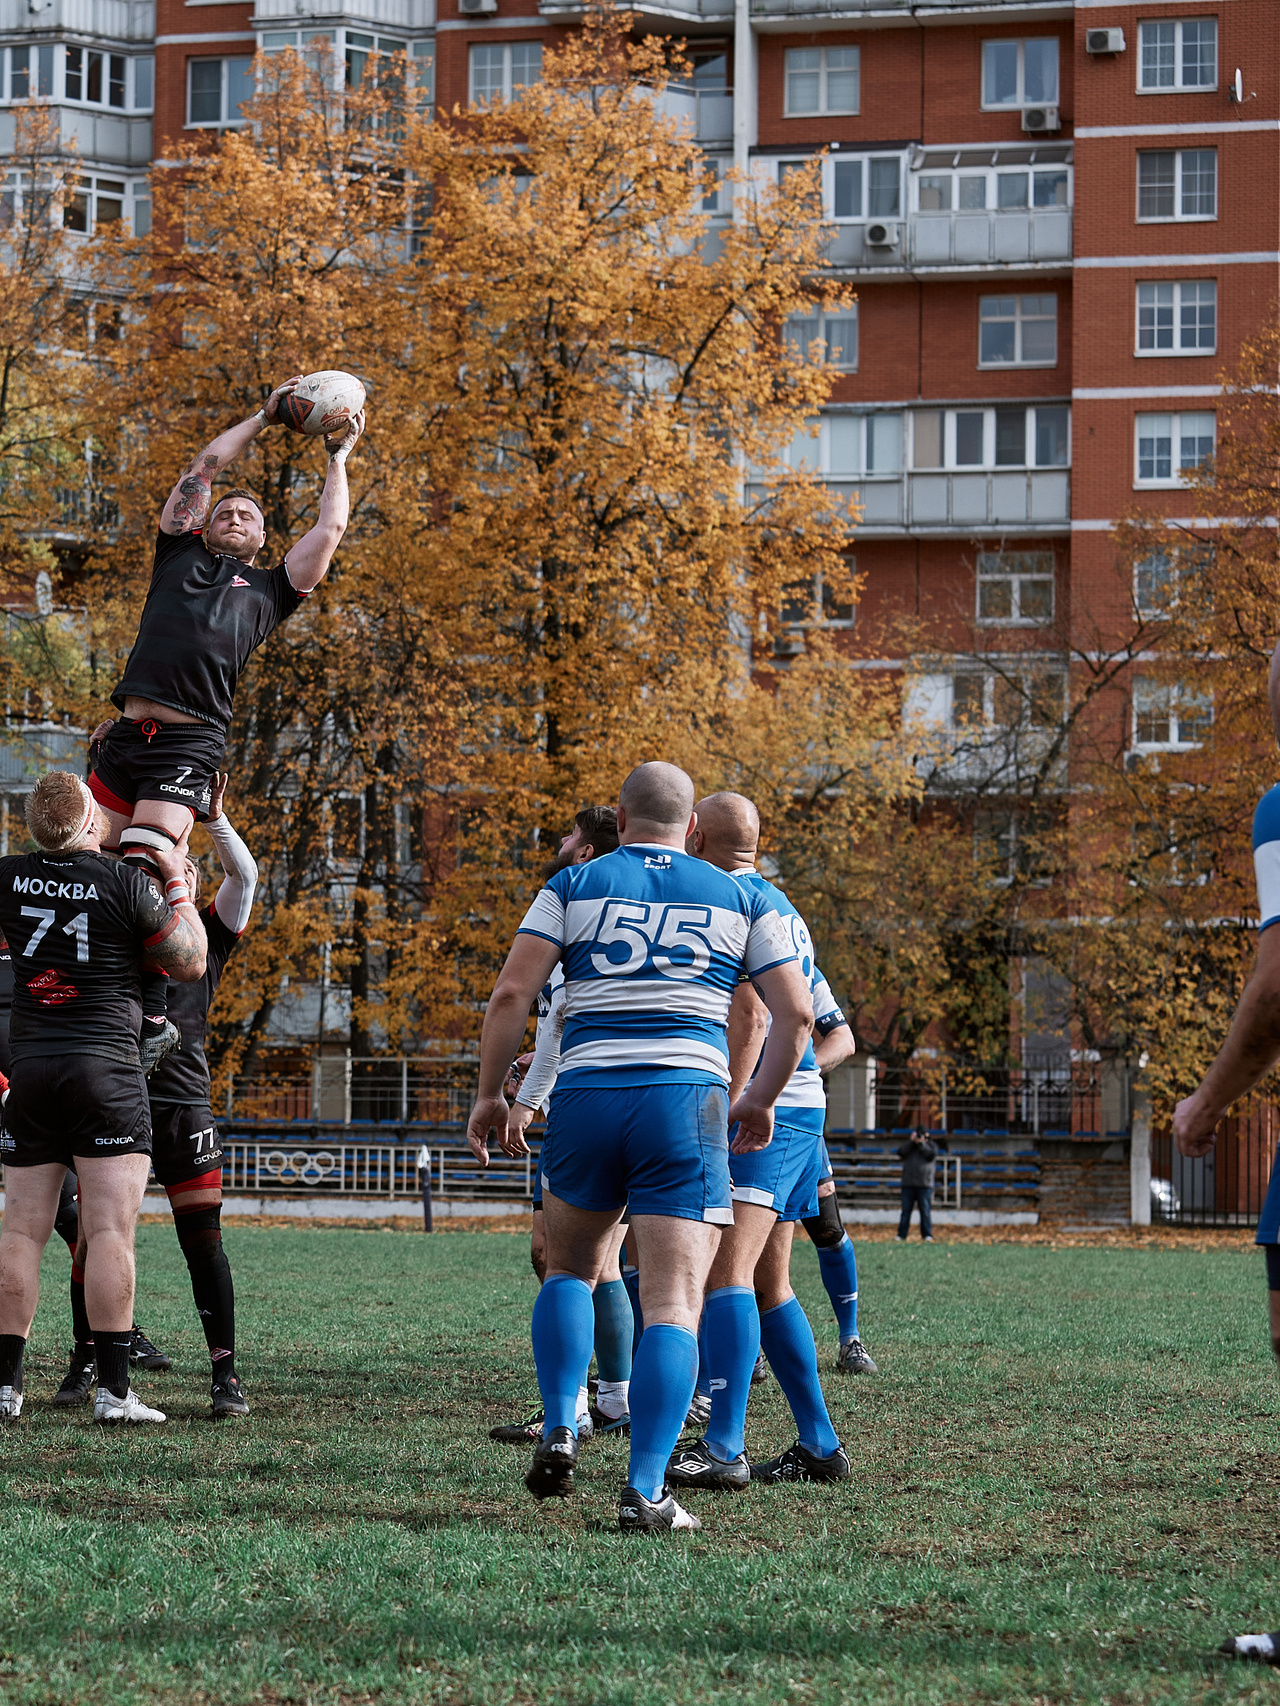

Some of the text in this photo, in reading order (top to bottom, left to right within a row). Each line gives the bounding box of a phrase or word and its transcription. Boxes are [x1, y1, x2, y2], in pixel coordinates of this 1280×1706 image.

[174, 766, 193, 784] 7
[13, 875, 99, 900] МОСКВА
[20, 905, 90, 963] 71
[590, 899, 712, 979] 55
[189, 1128, 215, 1153] 77
